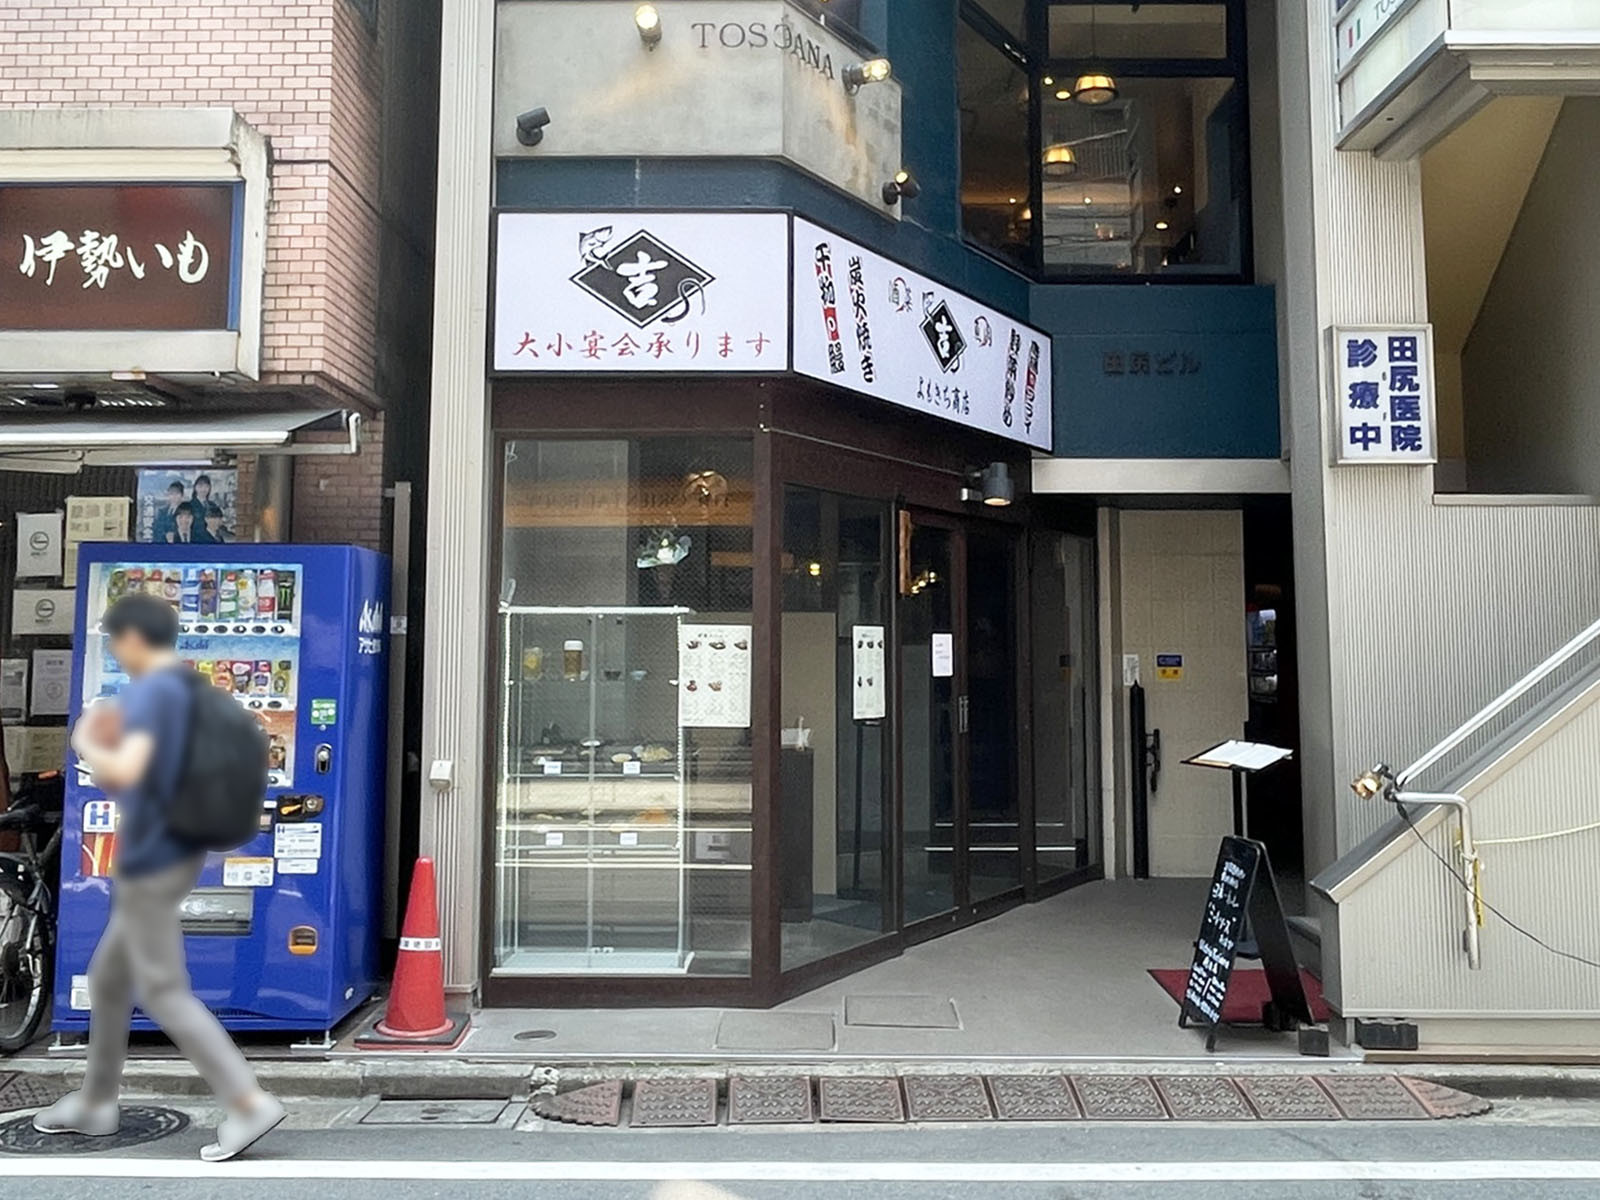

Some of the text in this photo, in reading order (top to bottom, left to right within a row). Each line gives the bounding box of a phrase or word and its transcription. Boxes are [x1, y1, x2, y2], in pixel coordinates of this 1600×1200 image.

[19, 230, 209, 289] 伊勢いも
[615, 249, 669, 309] 吉
[512, 329, 771, 360] 大小宴会承ります
[1346, 338, 1382, 451] 診療中
[1387, 336, 1423, 452] 田尻医院
